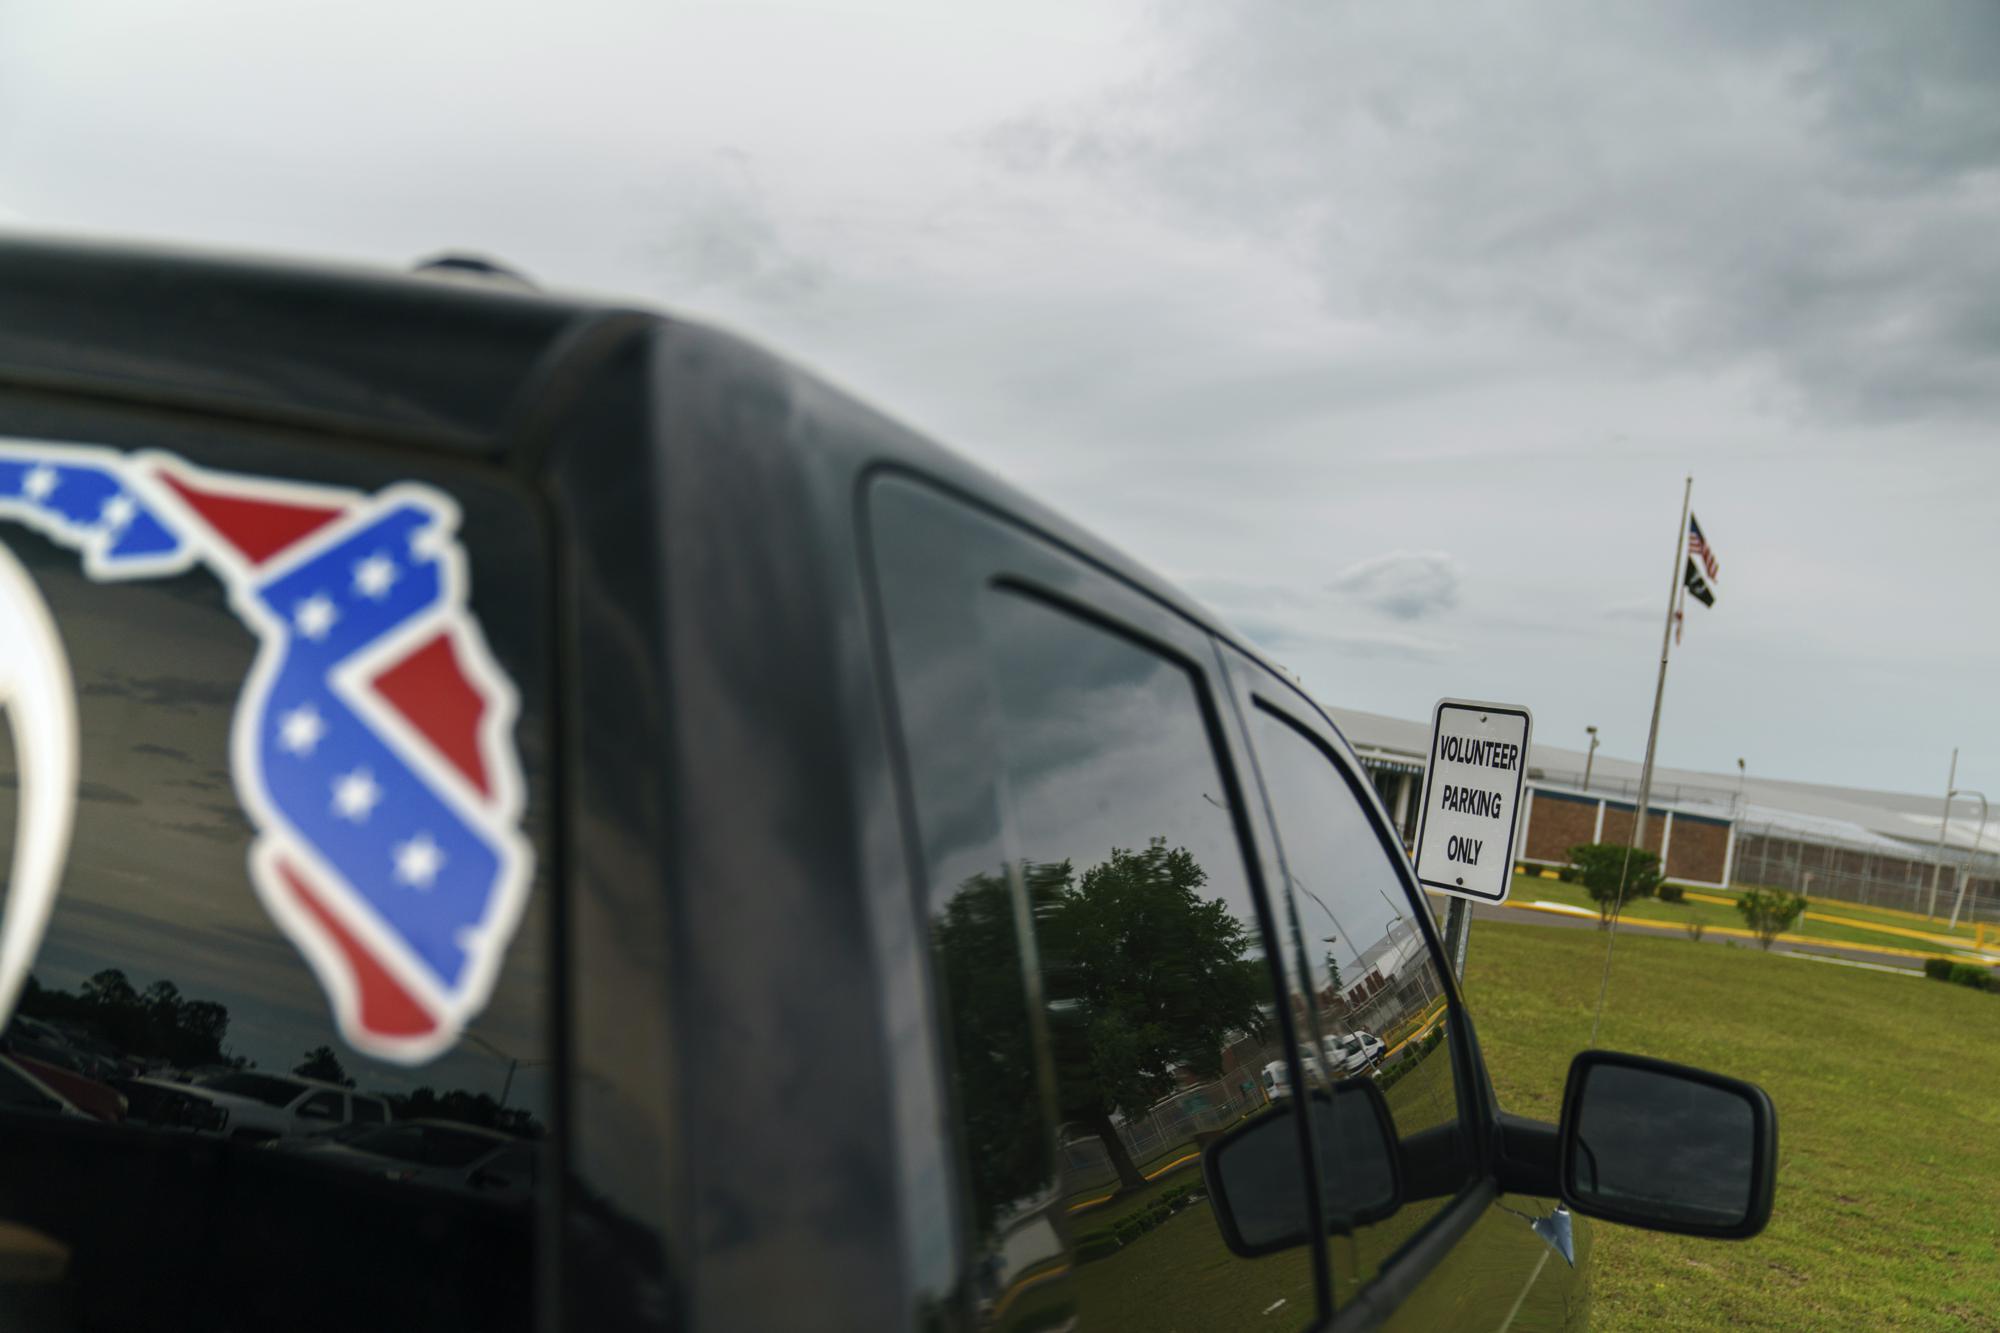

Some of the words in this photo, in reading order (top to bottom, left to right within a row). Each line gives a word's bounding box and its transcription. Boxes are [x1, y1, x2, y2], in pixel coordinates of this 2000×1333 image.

[1440, 735, 1519, 771] VOLUNTEER
[1441, 784, 1502, 819] PARKING
[1447, 835, 1483, 866] ONLY
